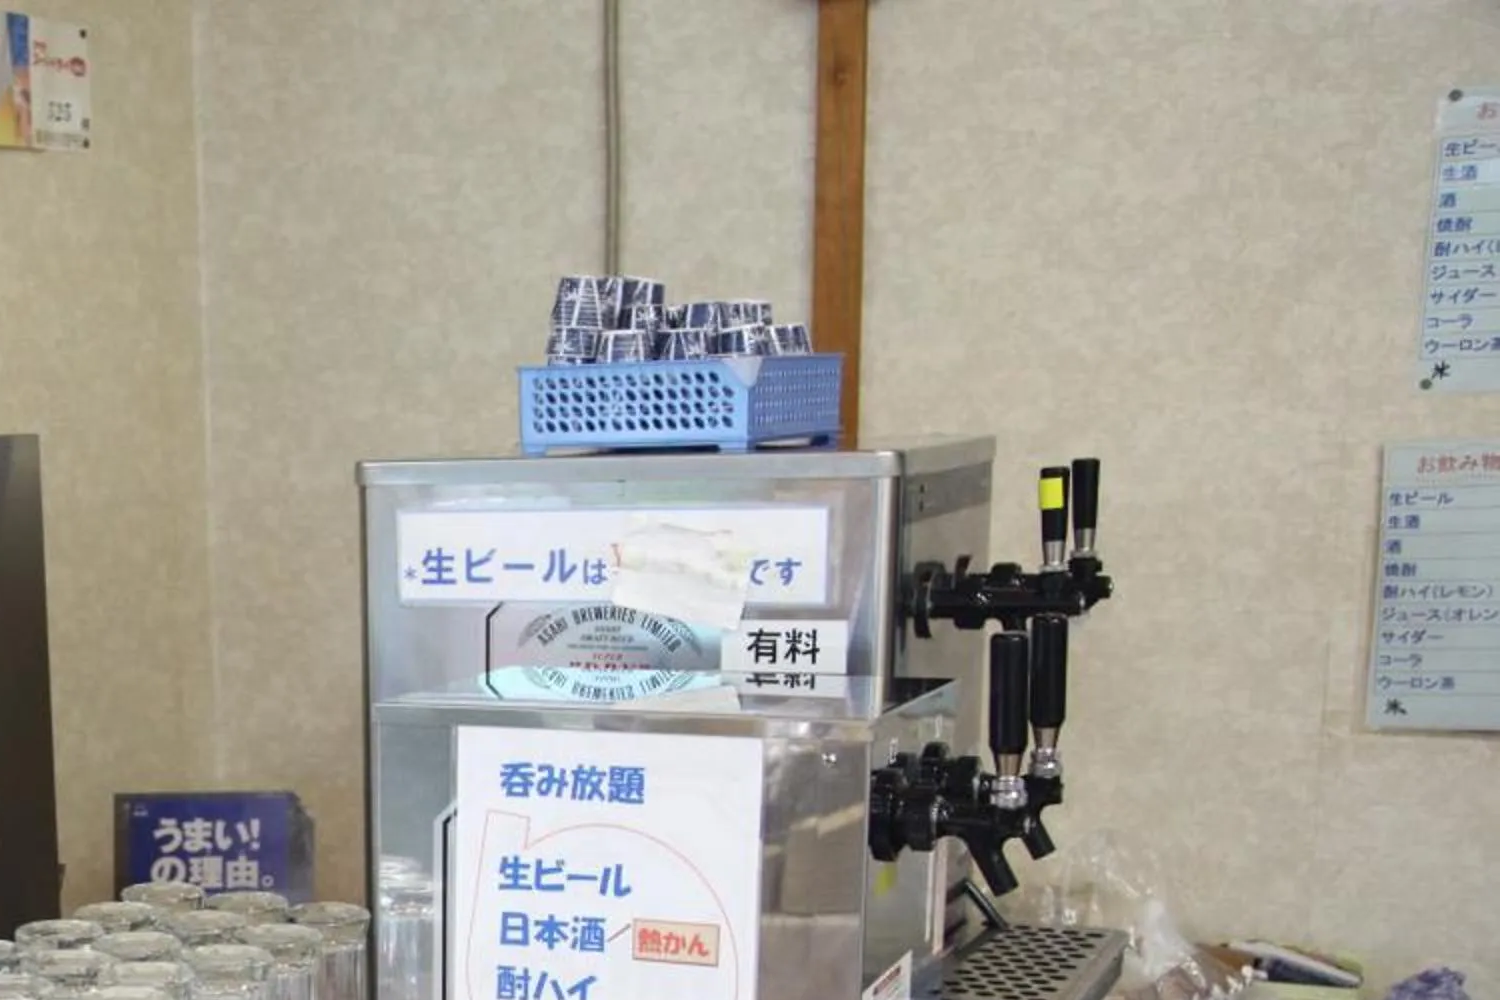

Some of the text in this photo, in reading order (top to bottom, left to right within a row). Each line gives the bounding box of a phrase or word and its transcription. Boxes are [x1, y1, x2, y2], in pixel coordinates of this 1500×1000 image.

[1444, 139, 1500, 157] 生ビー
[1431, 264, 1495, 280] ジュース
[1430, 287, 1497, 304] サイダー
[1426, 313, 1473, 329] コーラ
[1389, 490, 1454, 507] 生ビール
[421, 547, 608, 587] 生ビールは
[749, 558, 802, 586] です
[571, 605, 638, 626] BREWERIES
[747, 627, 821, 665] 有料
[1381, 629, 1444, 644] サイダー
[1379, 653, 1422, 668] コーラ
[500, 762, 645, 805] 呑み放題
[153, 817, 261, 853] うまい!
[151, 853, 275, 889] の理由。
[498, 855, 632, 897] 生ビール
[500, 911, 607, 953] 日本酒
[638, 927, 710, 957] 熱かん
